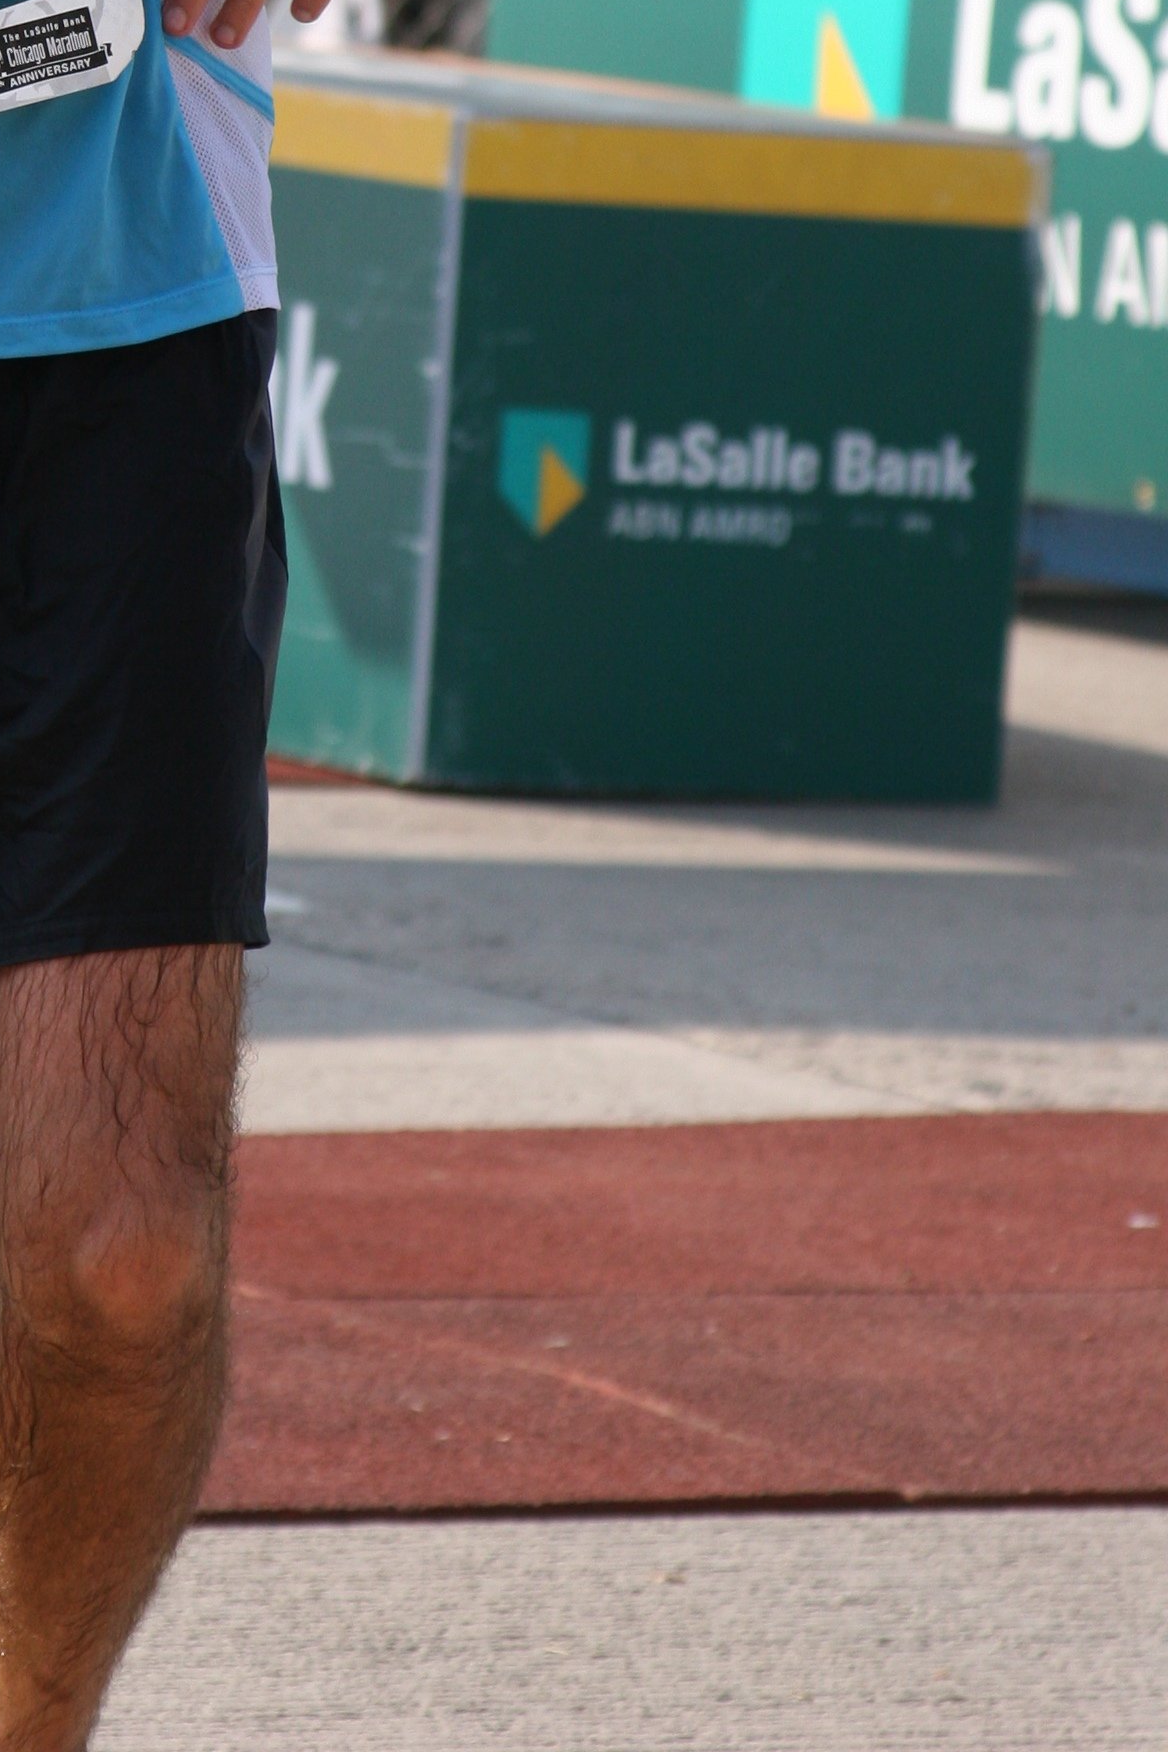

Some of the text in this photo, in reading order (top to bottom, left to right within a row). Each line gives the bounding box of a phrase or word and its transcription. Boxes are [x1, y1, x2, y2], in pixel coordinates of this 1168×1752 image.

[3, 15, 86, 43] The LaSalle Bank
[6, 30, 92, 67] Chicago Marathon
[10, 58, 91, 88] ANNIVERSARY
[612, 418, 976, 500] LaSalle Bank
